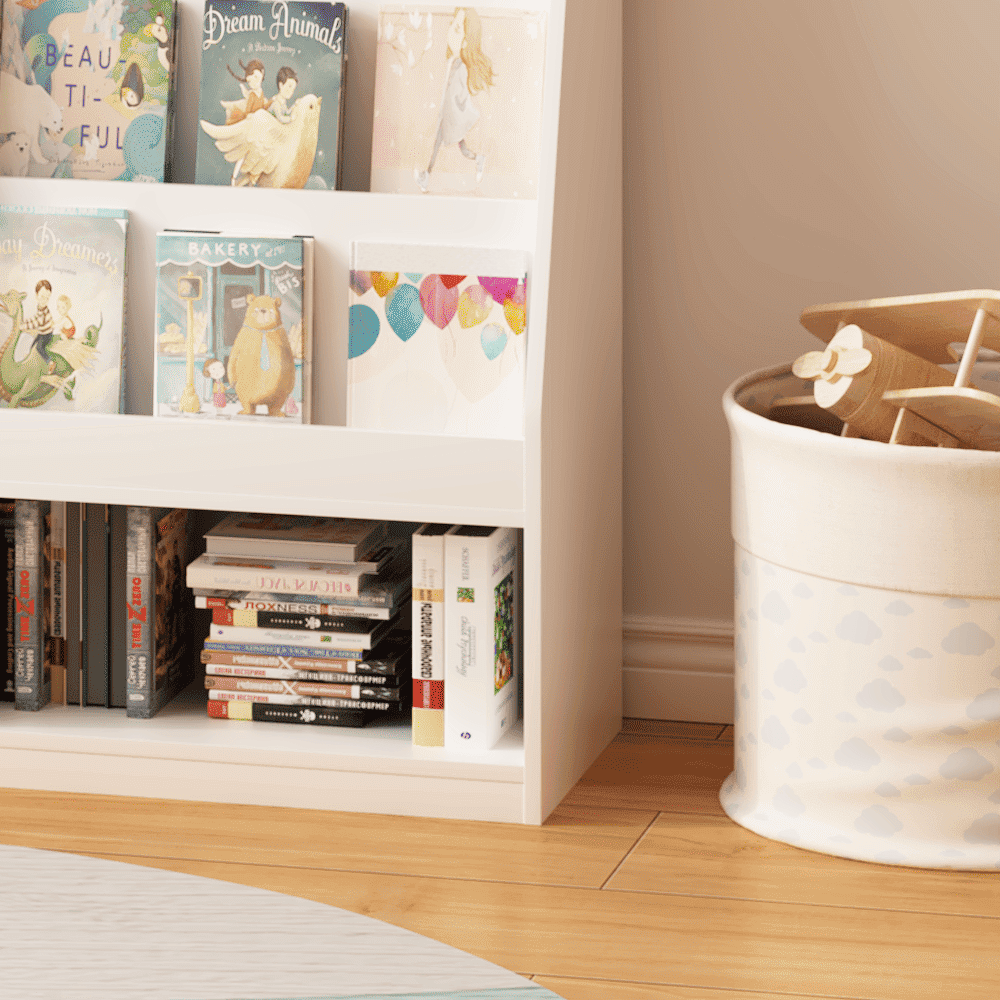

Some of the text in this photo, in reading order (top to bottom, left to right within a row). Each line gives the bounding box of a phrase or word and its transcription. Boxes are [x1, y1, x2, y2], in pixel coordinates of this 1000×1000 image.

[202, 1, 343, 54] Dream Animals
[45, 43, 127, 70] BEAU-
[65, 84, 102, 108] TI-
[80, 124, 123, 150] FUL
[30, 222, 119, 274] Dreamers
[188, 242, 261, 256] BAKERY
[132, 577, 142, 604] ZERO
[245, 601, 318, 614] ЛОХNESS
